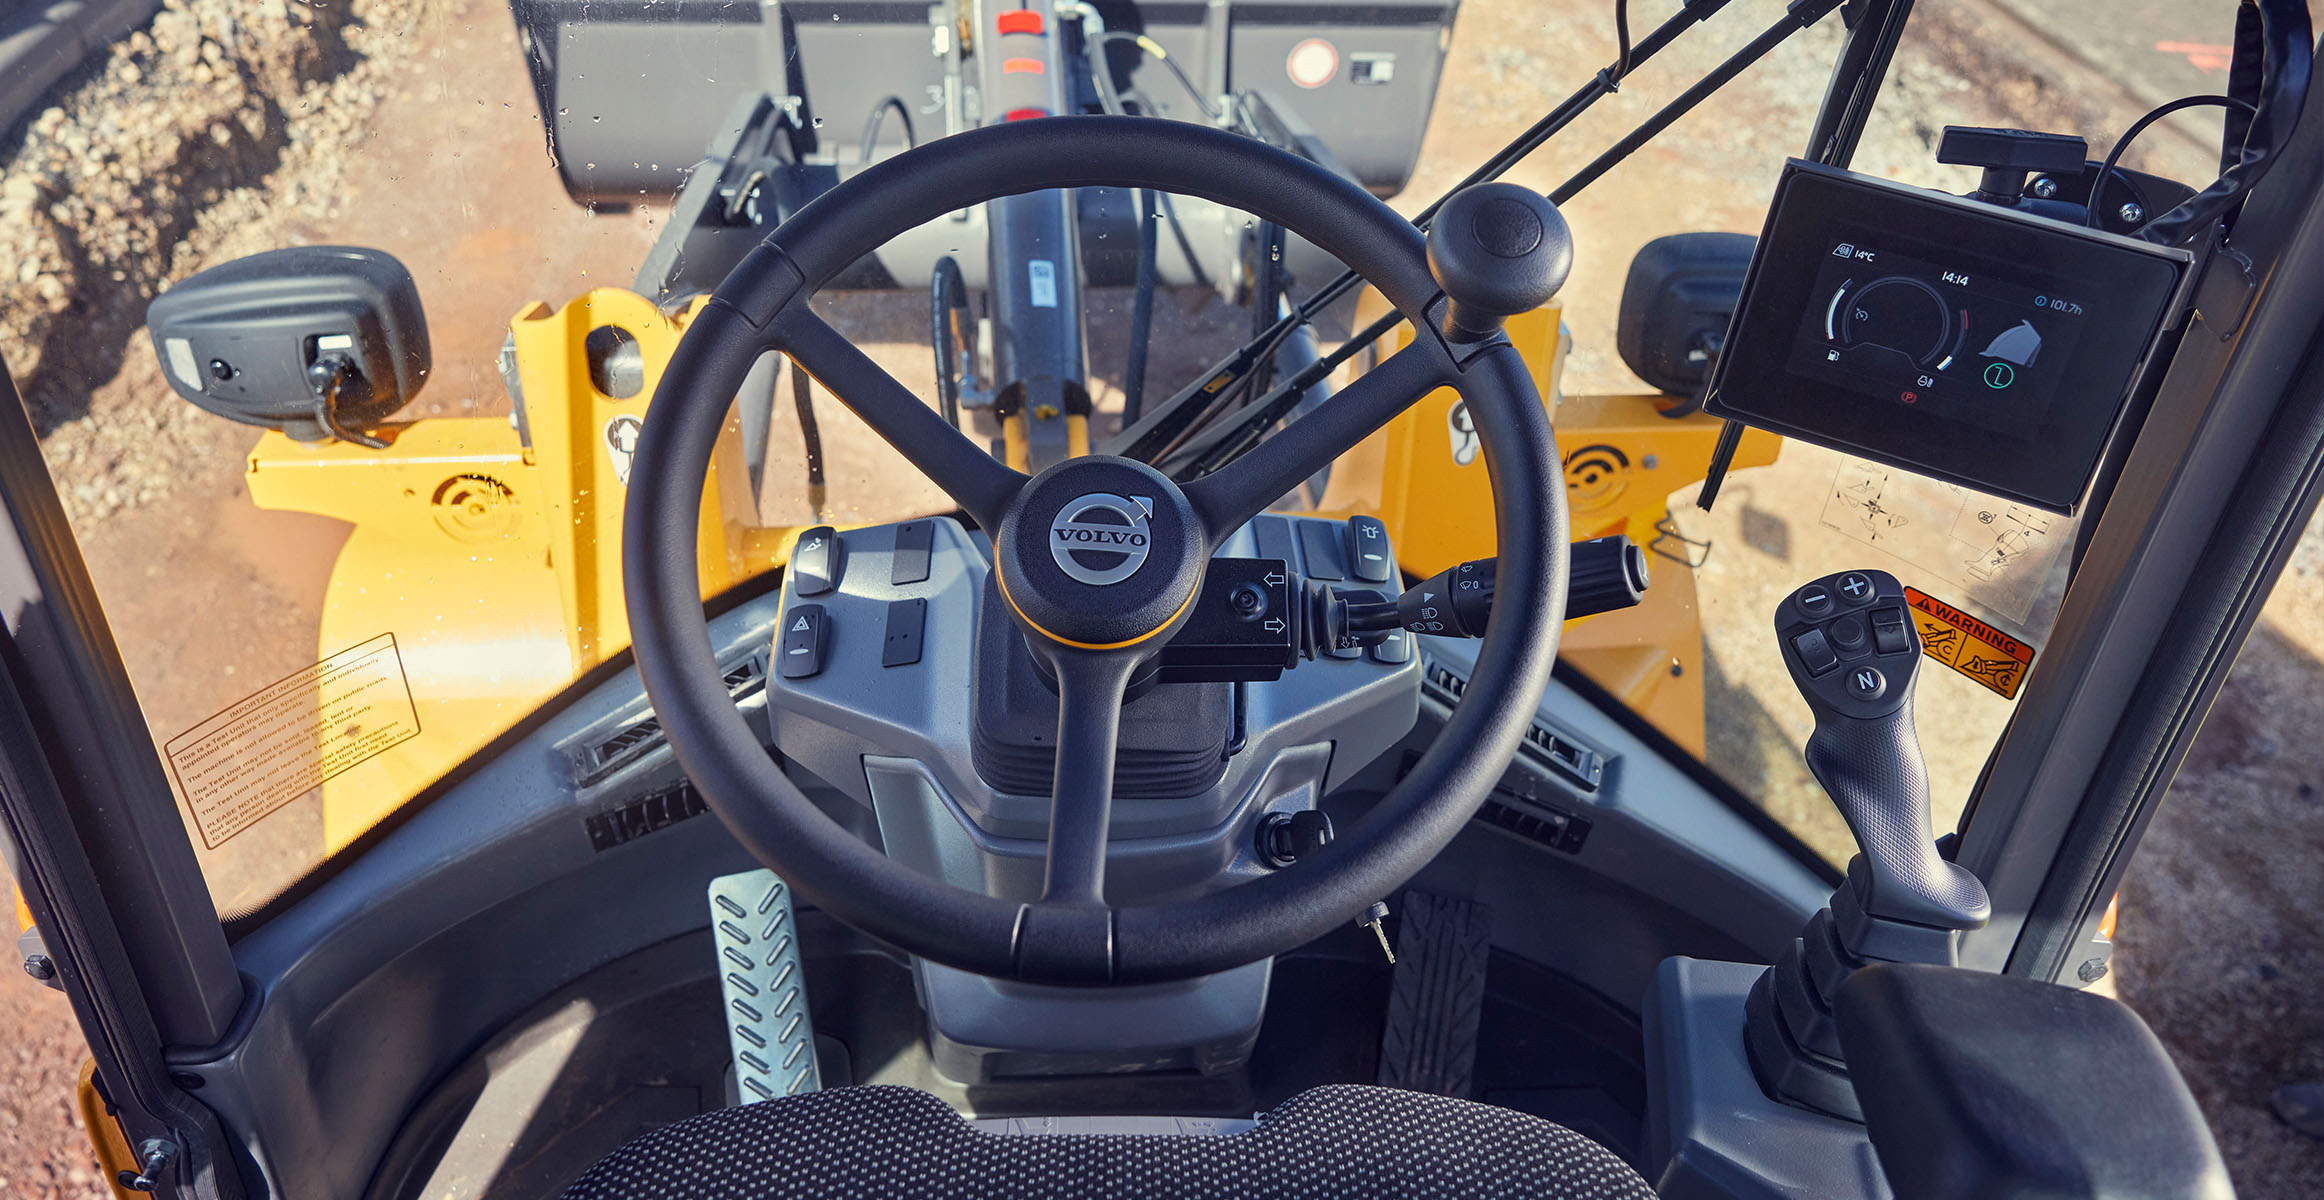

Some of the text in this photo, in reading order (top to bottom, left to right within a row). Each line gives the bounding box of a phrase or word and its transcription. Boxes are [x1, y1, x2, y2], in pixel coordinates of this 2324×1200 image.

[1941, 271, 1969, 286] 14:14
[2050, 298, 2082, 315] 101.7h
[1054, 529, 1147, 547] VOLVO
[1936, 604, 2017, 654] WARNING
[229, 662, 332, 718] IMPORTANT INFORMATION
[1857, 671, 1874, 689] N
[178, 751, 195, 763] This
[212, 731, 228, 743] Test
[229, 722, 244, 734] Unit
[246, 713, 261, 724] that
[262, 705, 278, 716] only
[322, 676, 336, 686] and
[181, 745, 219, 769] appointed
[221, 725, 256, 747] operators
[258, 716, 273, 726] may
[187, 772, 201, 783] The
[203, 753, 234, 774] machine
[244, 740, 256, 750] not
[258, 723, 286, 742] allowed
[193, 785, 207, 796] The
[208, 774, 224, 787] Test
[225, 764, 241, 777] Unit
[242, 755, 258, 767] may
[259, 747, 272, 757] not
[330, 710, 344, 719] lent
[201, 805, 215, 815] The
[216, 794, 232, 806] Test
[233, 784, 249, 796] Unit
[250, 775, 266, 786] may
[267, 766, 279, 776] not
[280, 756, 299, 769] leave
[300, 749, 312, 757] the
[314, 739, 329, 750] Test
[204, 787, 218, 798] any
[219, 775, 238, 789] other
[240, 765, 255, 776] way
[256, 754, 275, 767] made
[277, 735, 309, 755] available
[320, 724, 333, 732] any
[334, 714, 351, 725] third
[221, 828, 231, 836] be
[231, 807, 264, 829] informed
[265, 794, 285, 809] about
[286, 781, 309, 796] before
[311, 773, 323, 782] any
[324, 759, 351, 775] dealing
[352, 750, 366, 761] with
[367, 744, 379, 752] the
[381, 736, 395, 746] Test
[396, 728, 411, 738] Unit
[206, 807, 236, 828] PLEASE
[237, 794, 258, 809] NOTE
[260, 784, 274, 796] that
[275, 774, 294, 787] there
[295, 766, 307, 775] are
[335, 741, 356, 754] safety
[209, 732, 387, 835] that any person dealing with the Test Unit first need
